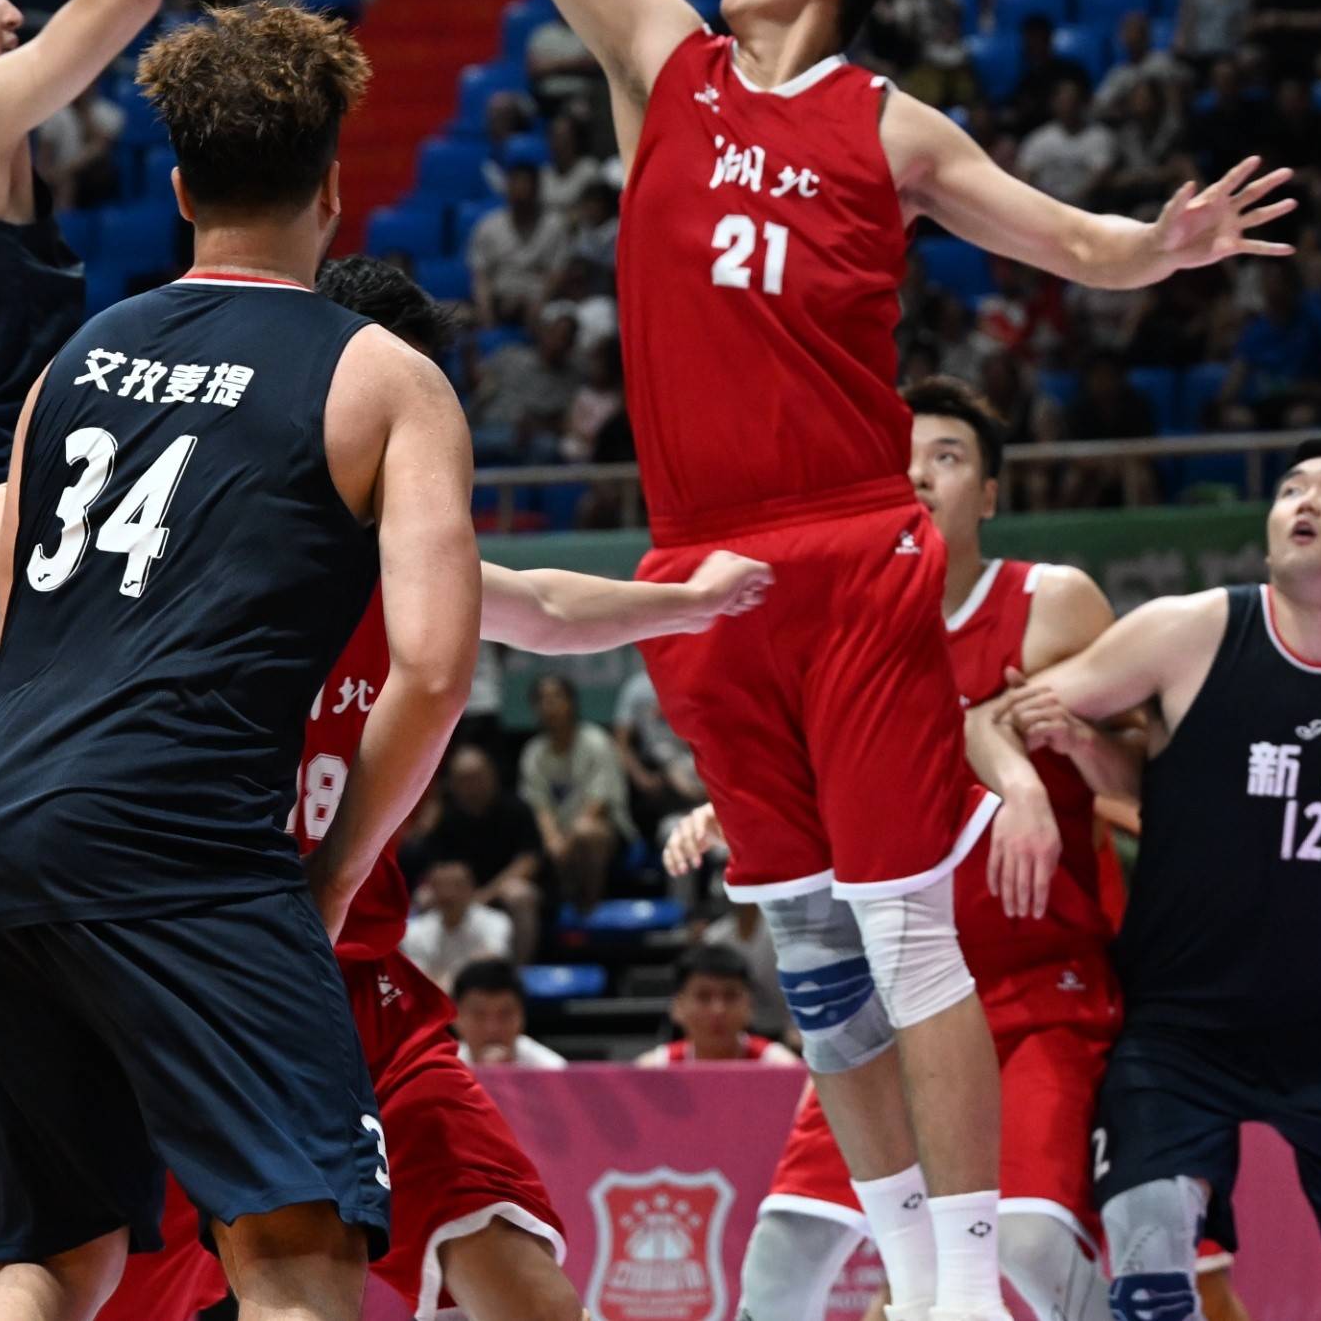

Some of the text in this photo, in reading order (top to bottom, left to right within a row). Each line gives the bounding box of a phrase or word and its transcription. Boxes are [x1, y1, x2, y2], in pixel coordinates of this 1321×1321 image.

[708, 134, 821, 198] 湖北
[710, 213, 790, 296] 21
[72, 347, 255, 408] 艾孜麦提
[25, 426, 198, 599] 34
[310, 676, 374, 720] 北
